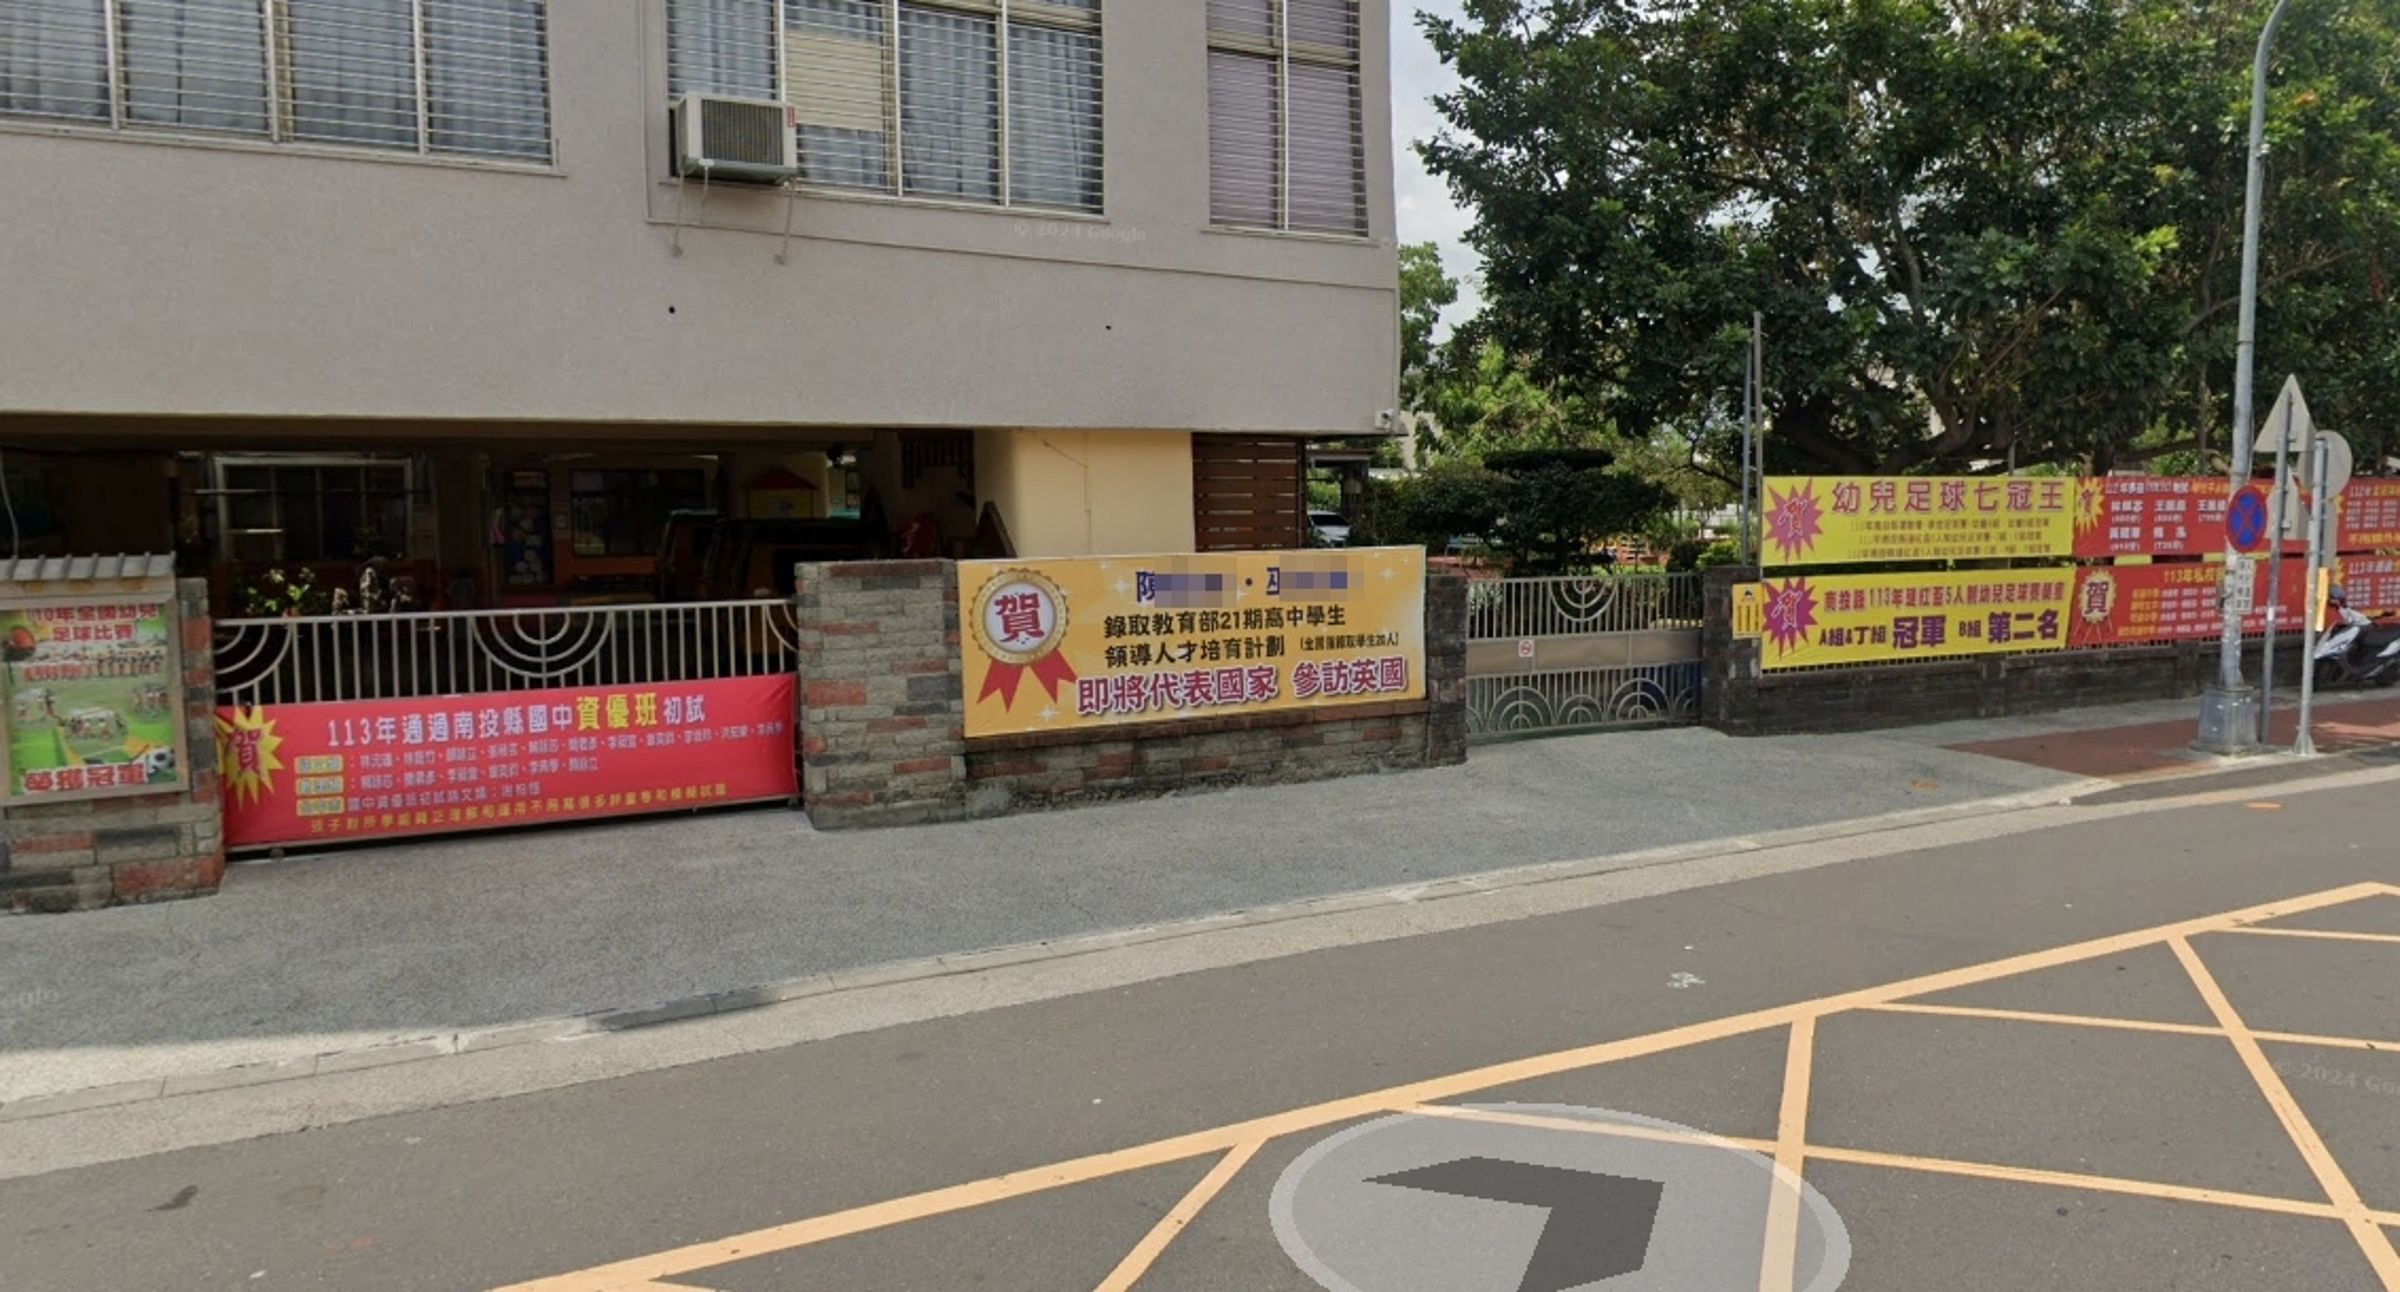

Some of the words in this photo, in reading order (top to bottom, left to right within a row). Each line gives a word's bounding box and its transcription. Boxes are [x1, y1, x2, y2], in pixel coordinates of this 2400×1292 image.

[1832, 481, 2064, 514] 幼兒足球七冠王
[2085, 581, 2107, 614] 賀
[52, 624, 134, 642] 足球比賽
[994, 593, 1045, 644] 賀
[1104, 604, 1346, 639] 錄取教育部21期高中學生
[1893, 613, 1947, 650] 冠軍
[1988, 609, 2059, 644] 第二名
[1104, 635, 1285, 668] 領導人才培育計劃
[1078, 664, 1278, 715] 即將代表國家
[1293, 655, 1408, 696] 參訪英國
[227, 729, 263, 775] 賀
